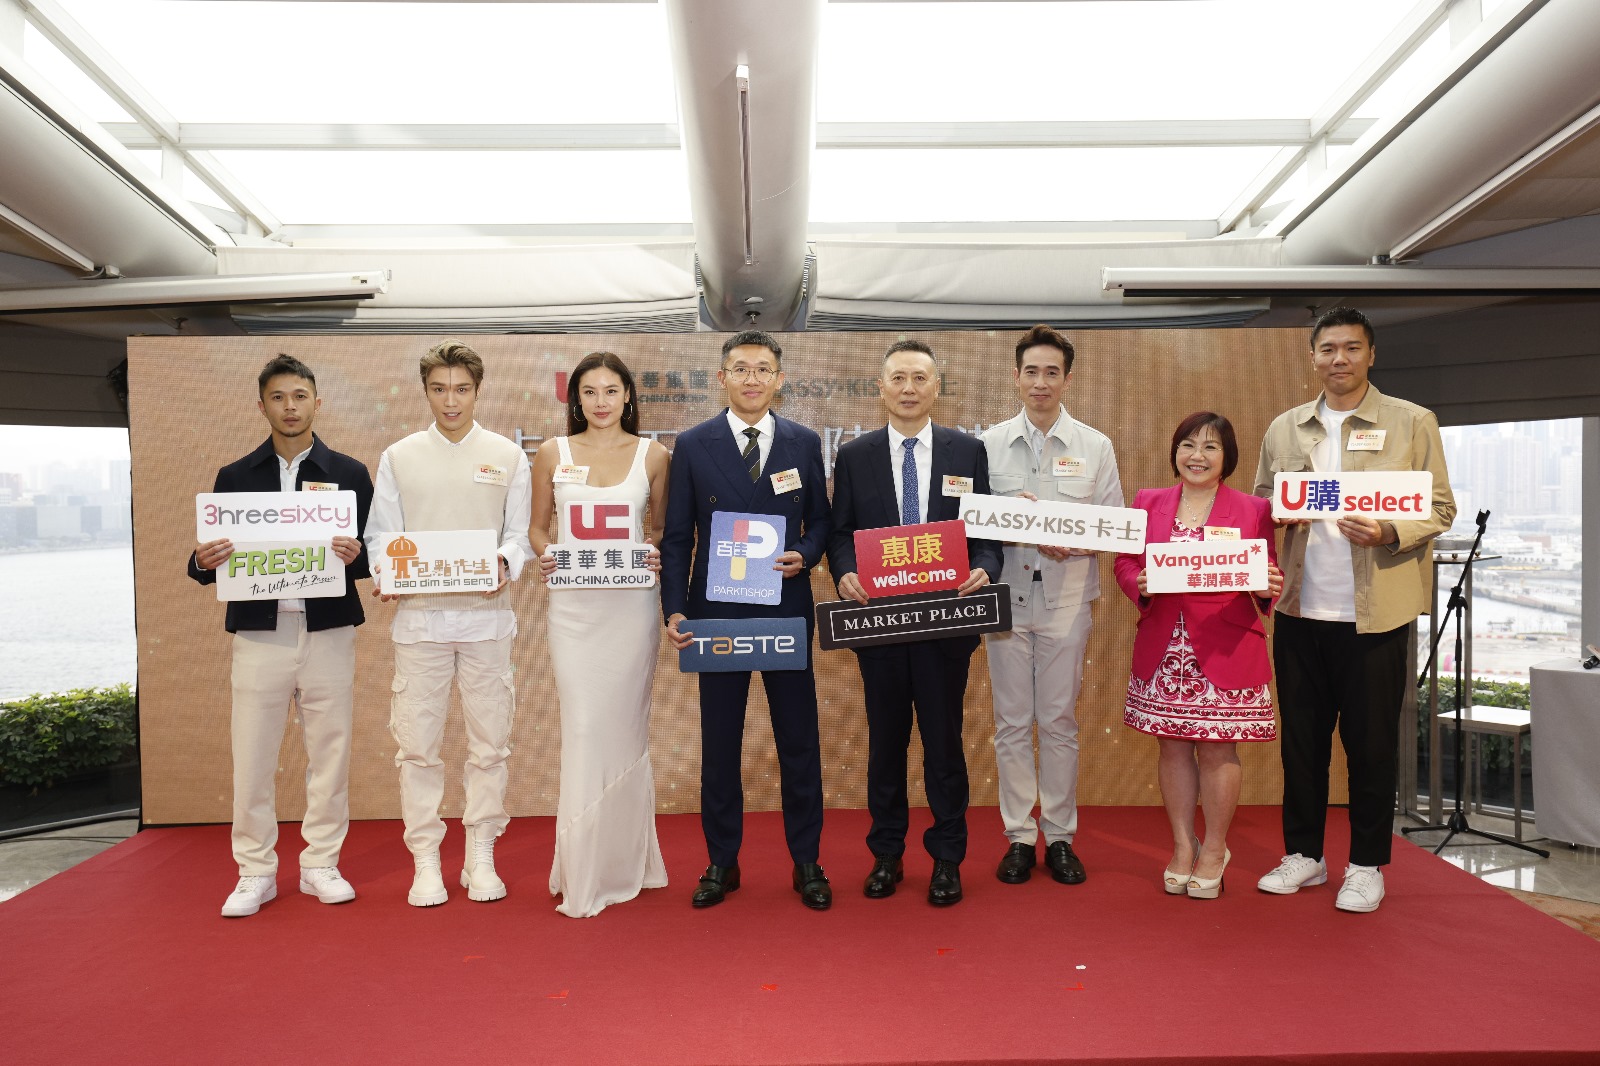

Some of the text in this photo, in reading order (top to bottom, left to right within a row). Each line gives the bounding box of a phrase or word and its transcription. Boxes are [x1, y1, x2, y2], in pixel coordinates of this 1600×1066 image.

[630, 371, 708, 389] 華集團
[1344, 491, 1423, 512] select
[204, 503, 350, 529] 3hreesixty
[1090, 518, 1141, 542] 卡士
[551, 549, 651, 570] 建華集團
[880, 533, 944, 567] 惠康
[1152, 550, 1249, 571] Vanguard
[228, 546, 326, 578] FRESH
[394, 577, 493, 588] bao dim sin seng
[551, 575, 651, 585] UNI-CHINA GROUP
[872, 568, 957, 589] wellcome
[1187, 572, 1250, 588] 華潤萬家
[844, 604, 987, 631] MARKET PLACE
